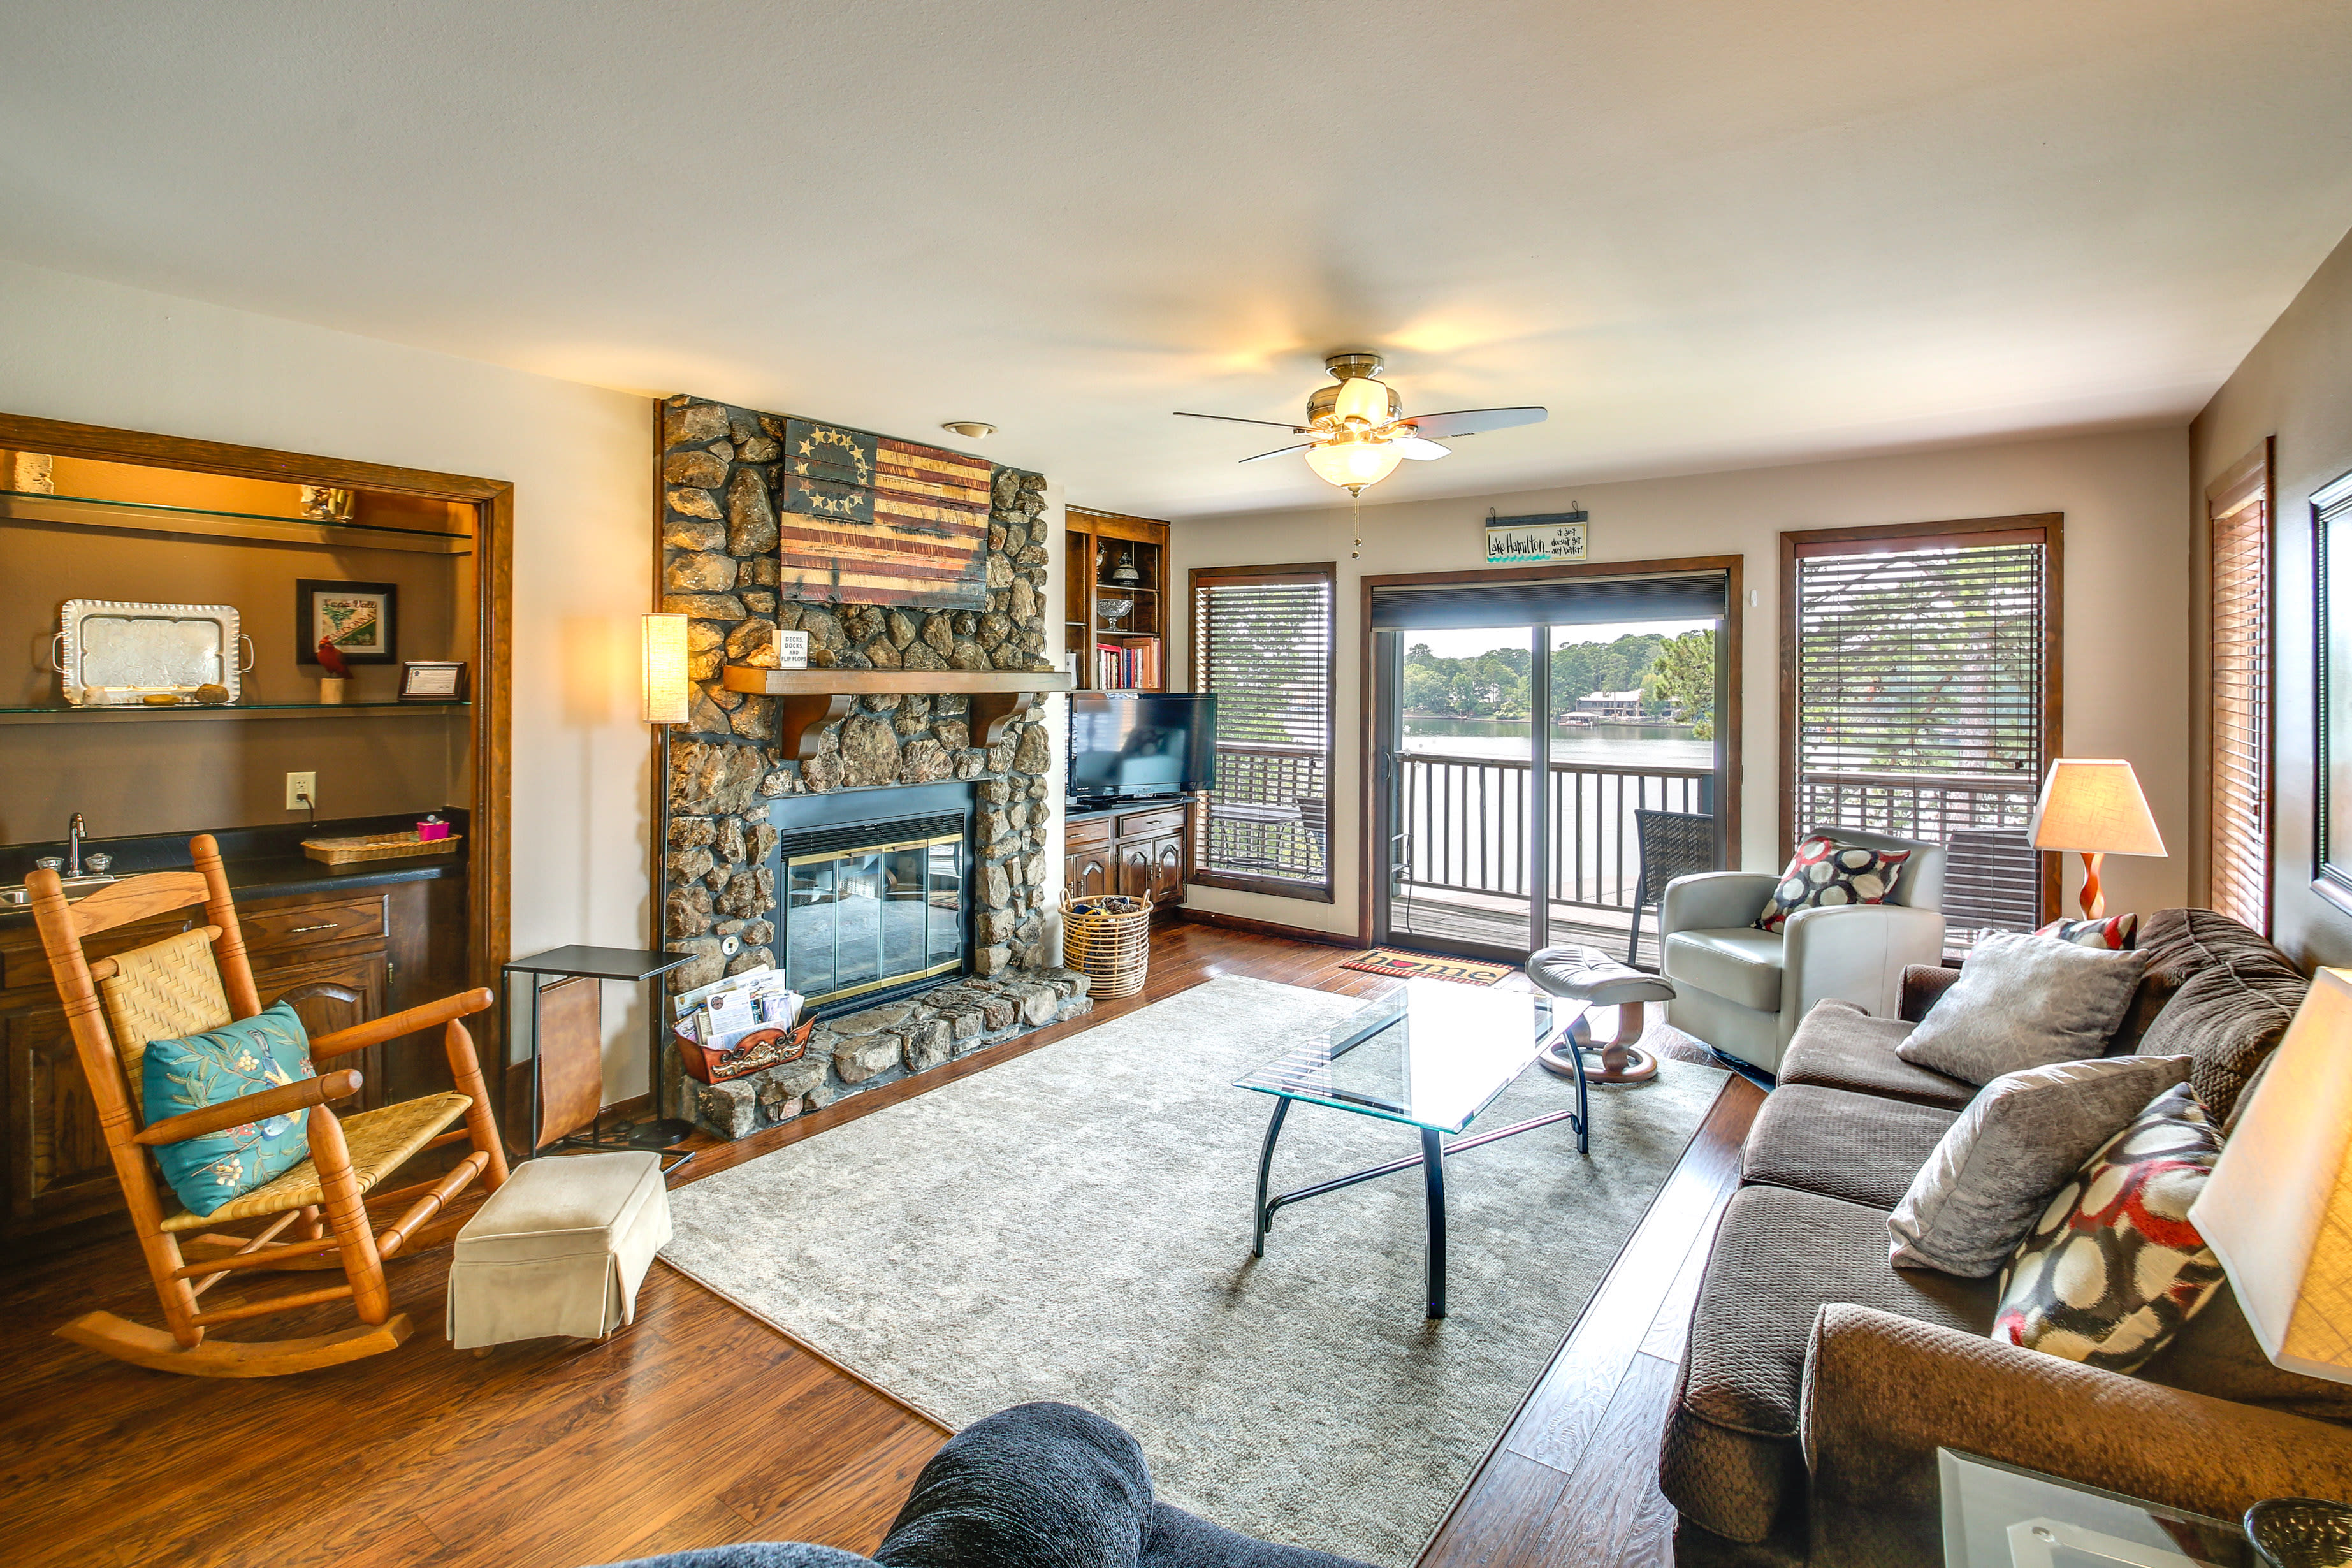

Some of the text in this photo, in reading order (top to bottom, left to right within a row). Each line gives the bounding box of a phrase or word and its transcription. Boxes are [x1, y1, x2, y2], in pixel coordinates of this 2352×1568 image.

[1557, 527, 1576, 537] it just
[1488, 534, 1505, 556] Lake
[1572, 536, 1581, 546] get
[1551, 546, 1562, 556] any
